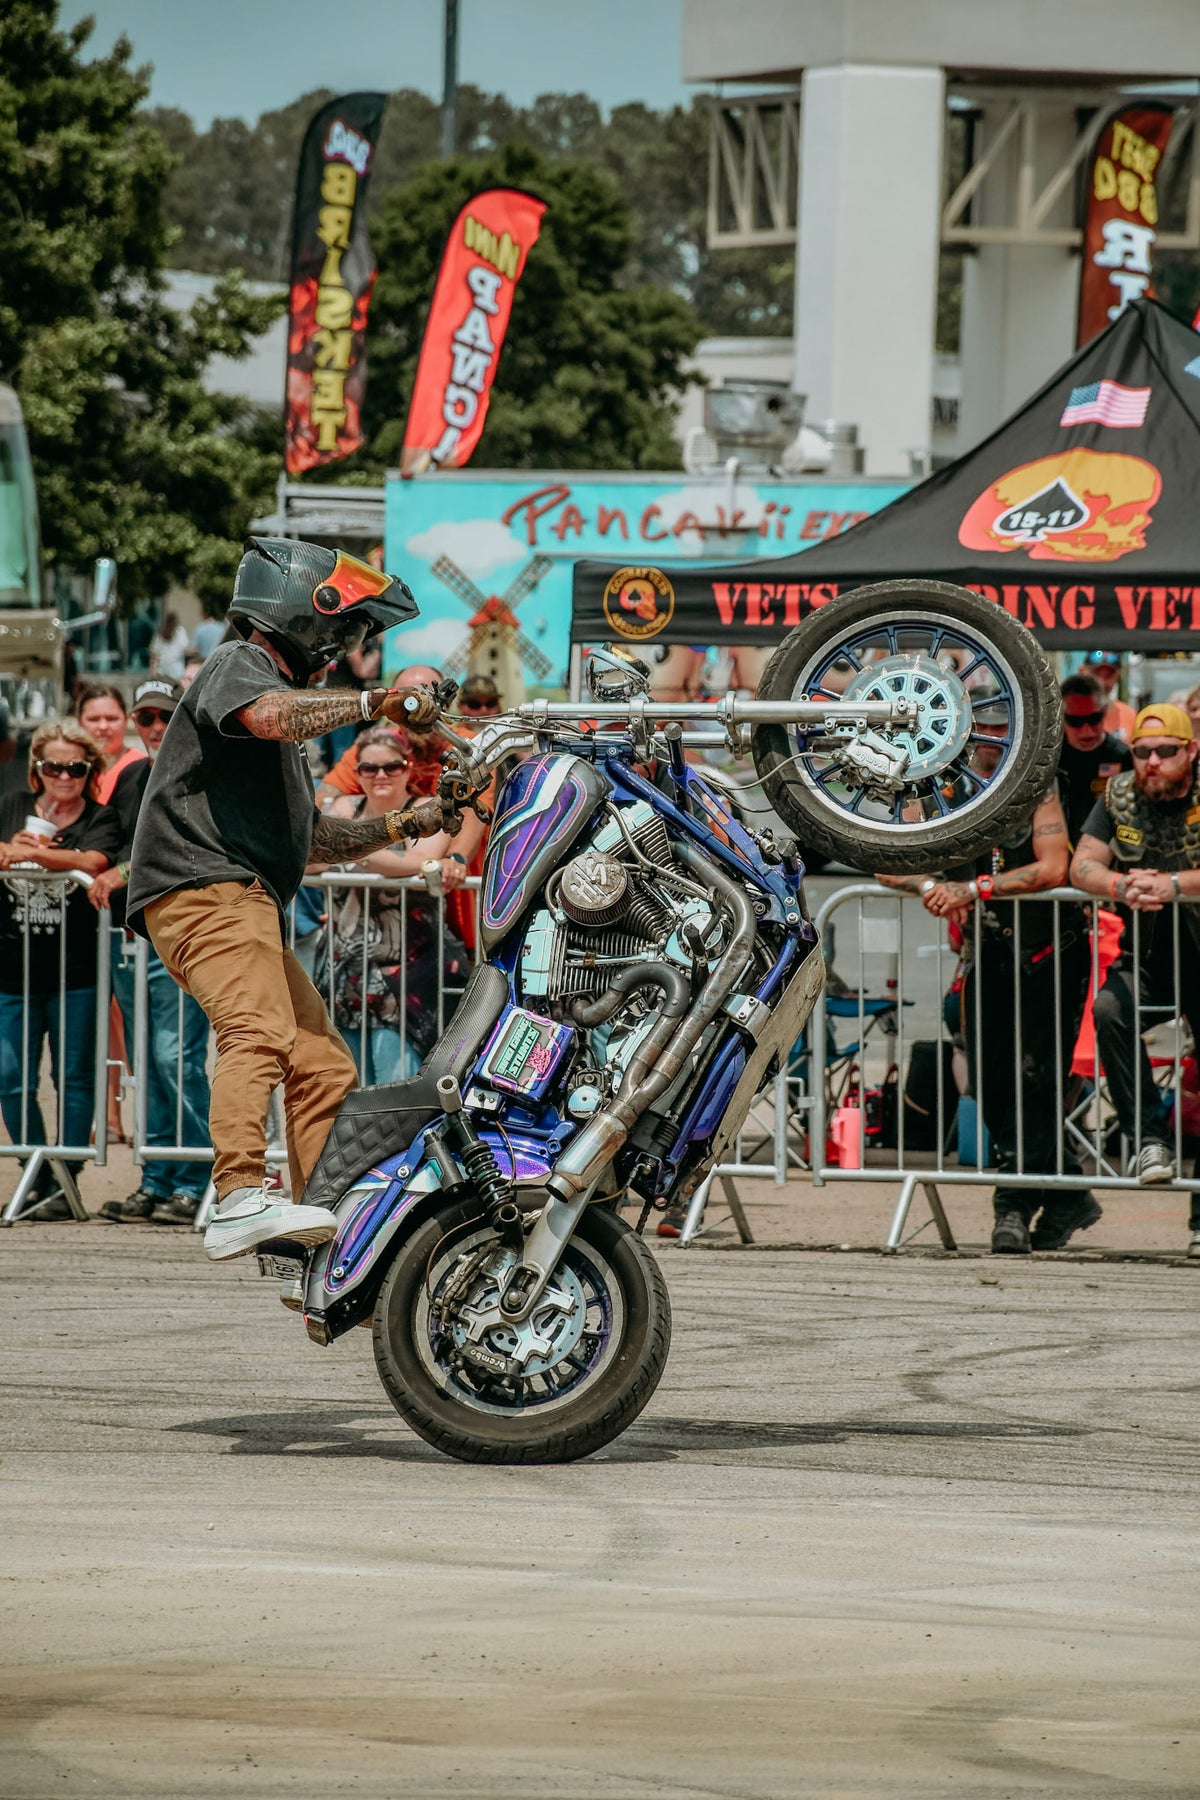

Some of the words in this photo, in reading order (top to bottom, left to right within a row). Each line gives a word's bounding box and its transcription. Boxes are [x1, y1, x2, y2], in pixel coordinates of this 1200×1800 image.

[1008, 508, 1075, 531] 15-11
[16, 906, 63, 925] SRONG
[509, 1029, 539, 1077] STUNTS
[470, 1349, 507, 1371] brembo
